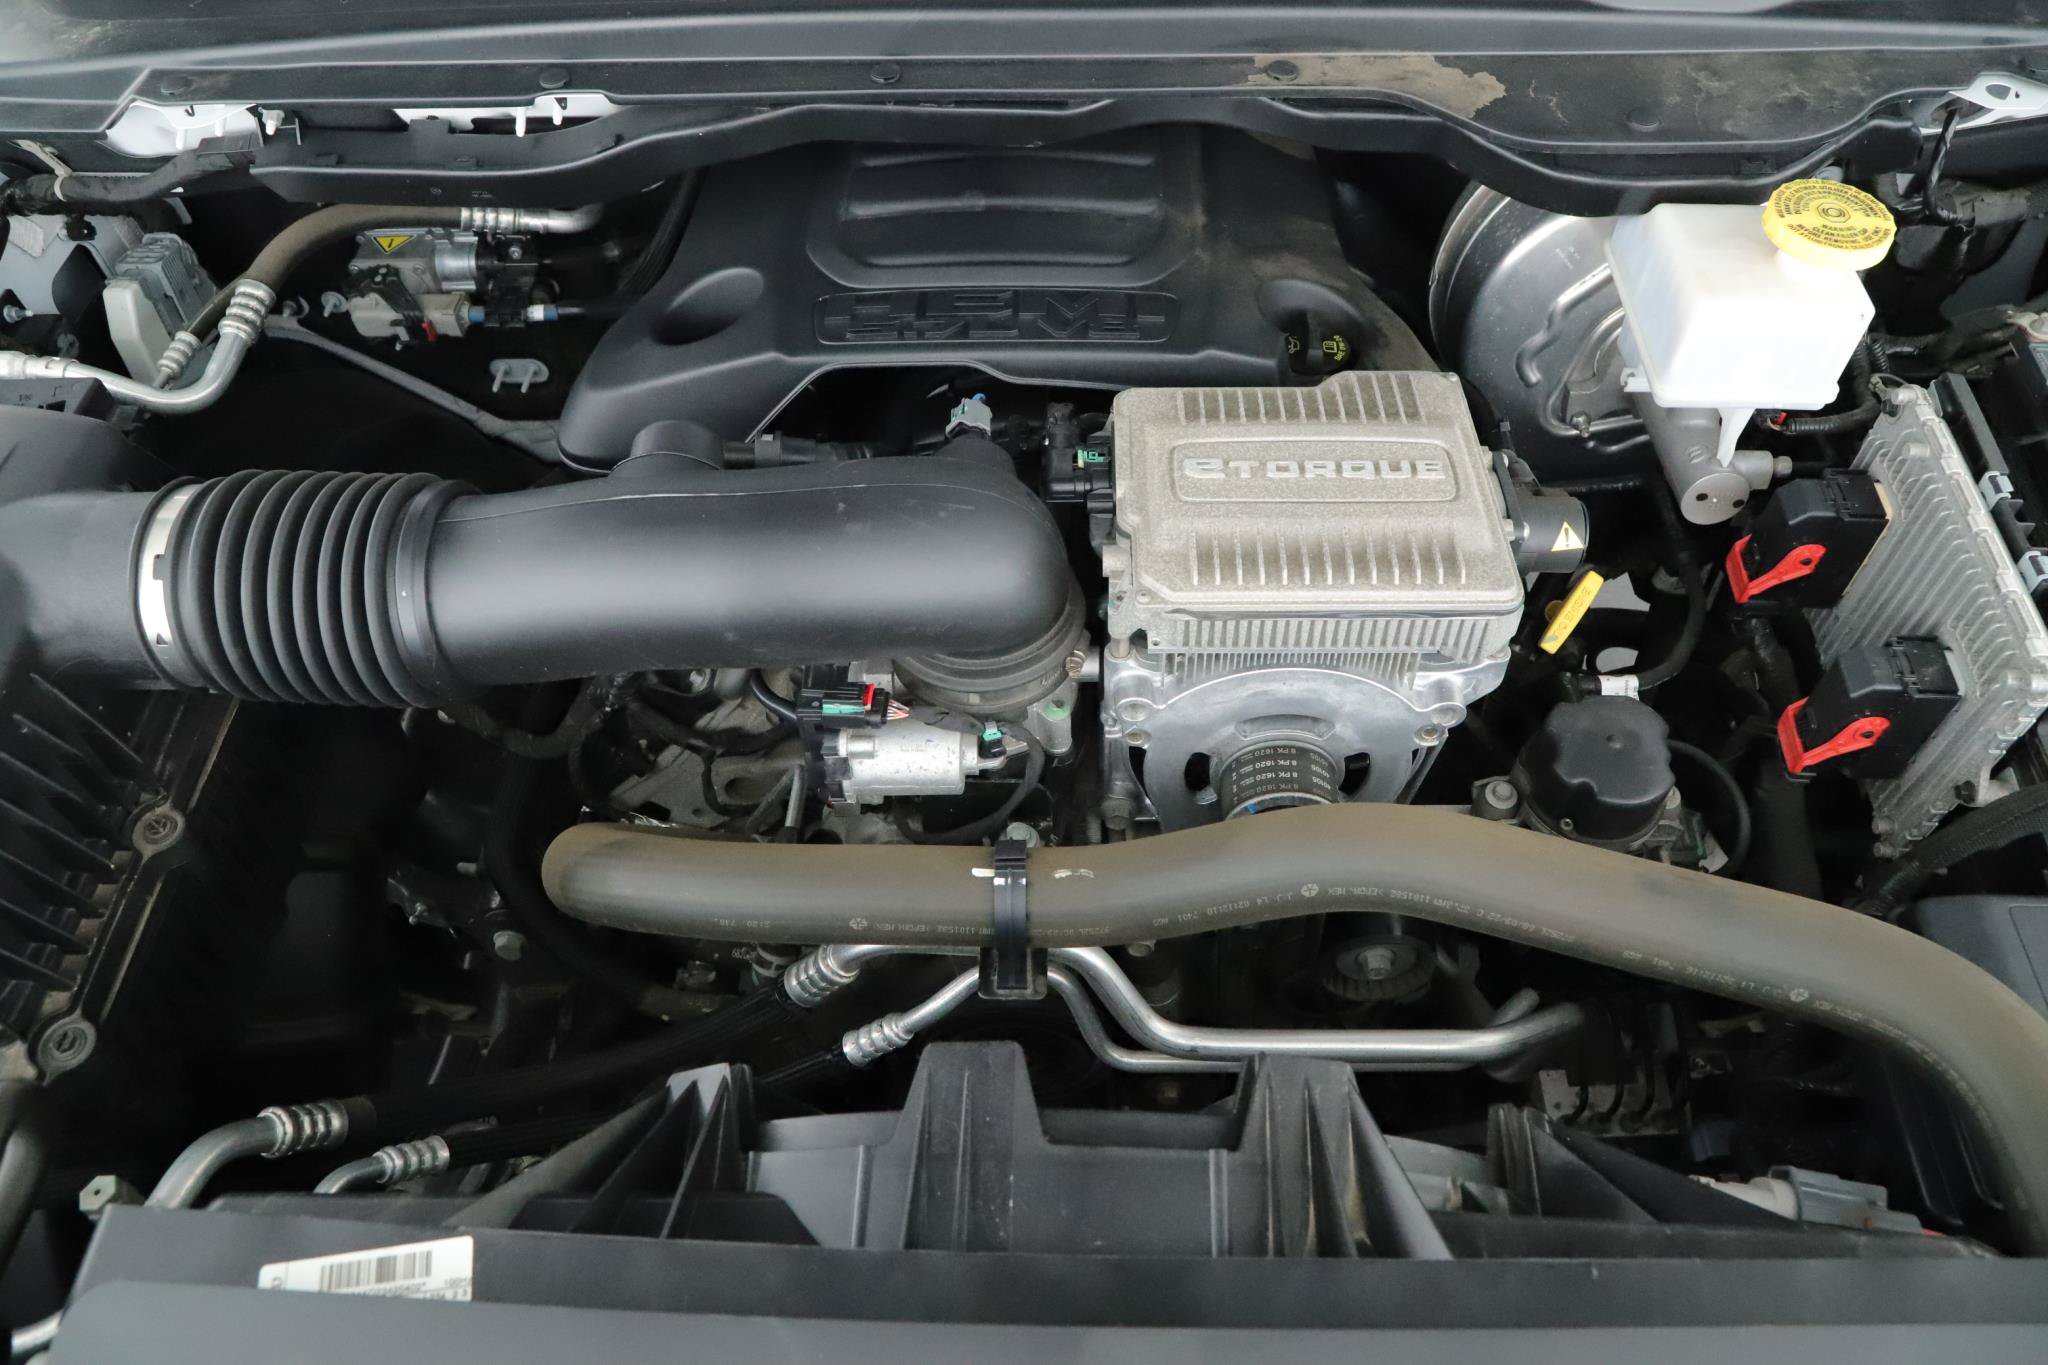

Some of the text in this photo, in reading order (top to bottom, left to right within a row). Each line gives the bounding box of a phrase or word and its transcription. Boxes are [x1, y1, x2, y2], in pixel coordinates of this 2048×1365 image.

[1254, 748, 1274, 757] 1620
[1255, 760, 1275, 769] 1620
[1255, 772, 1277, 781] 1620
